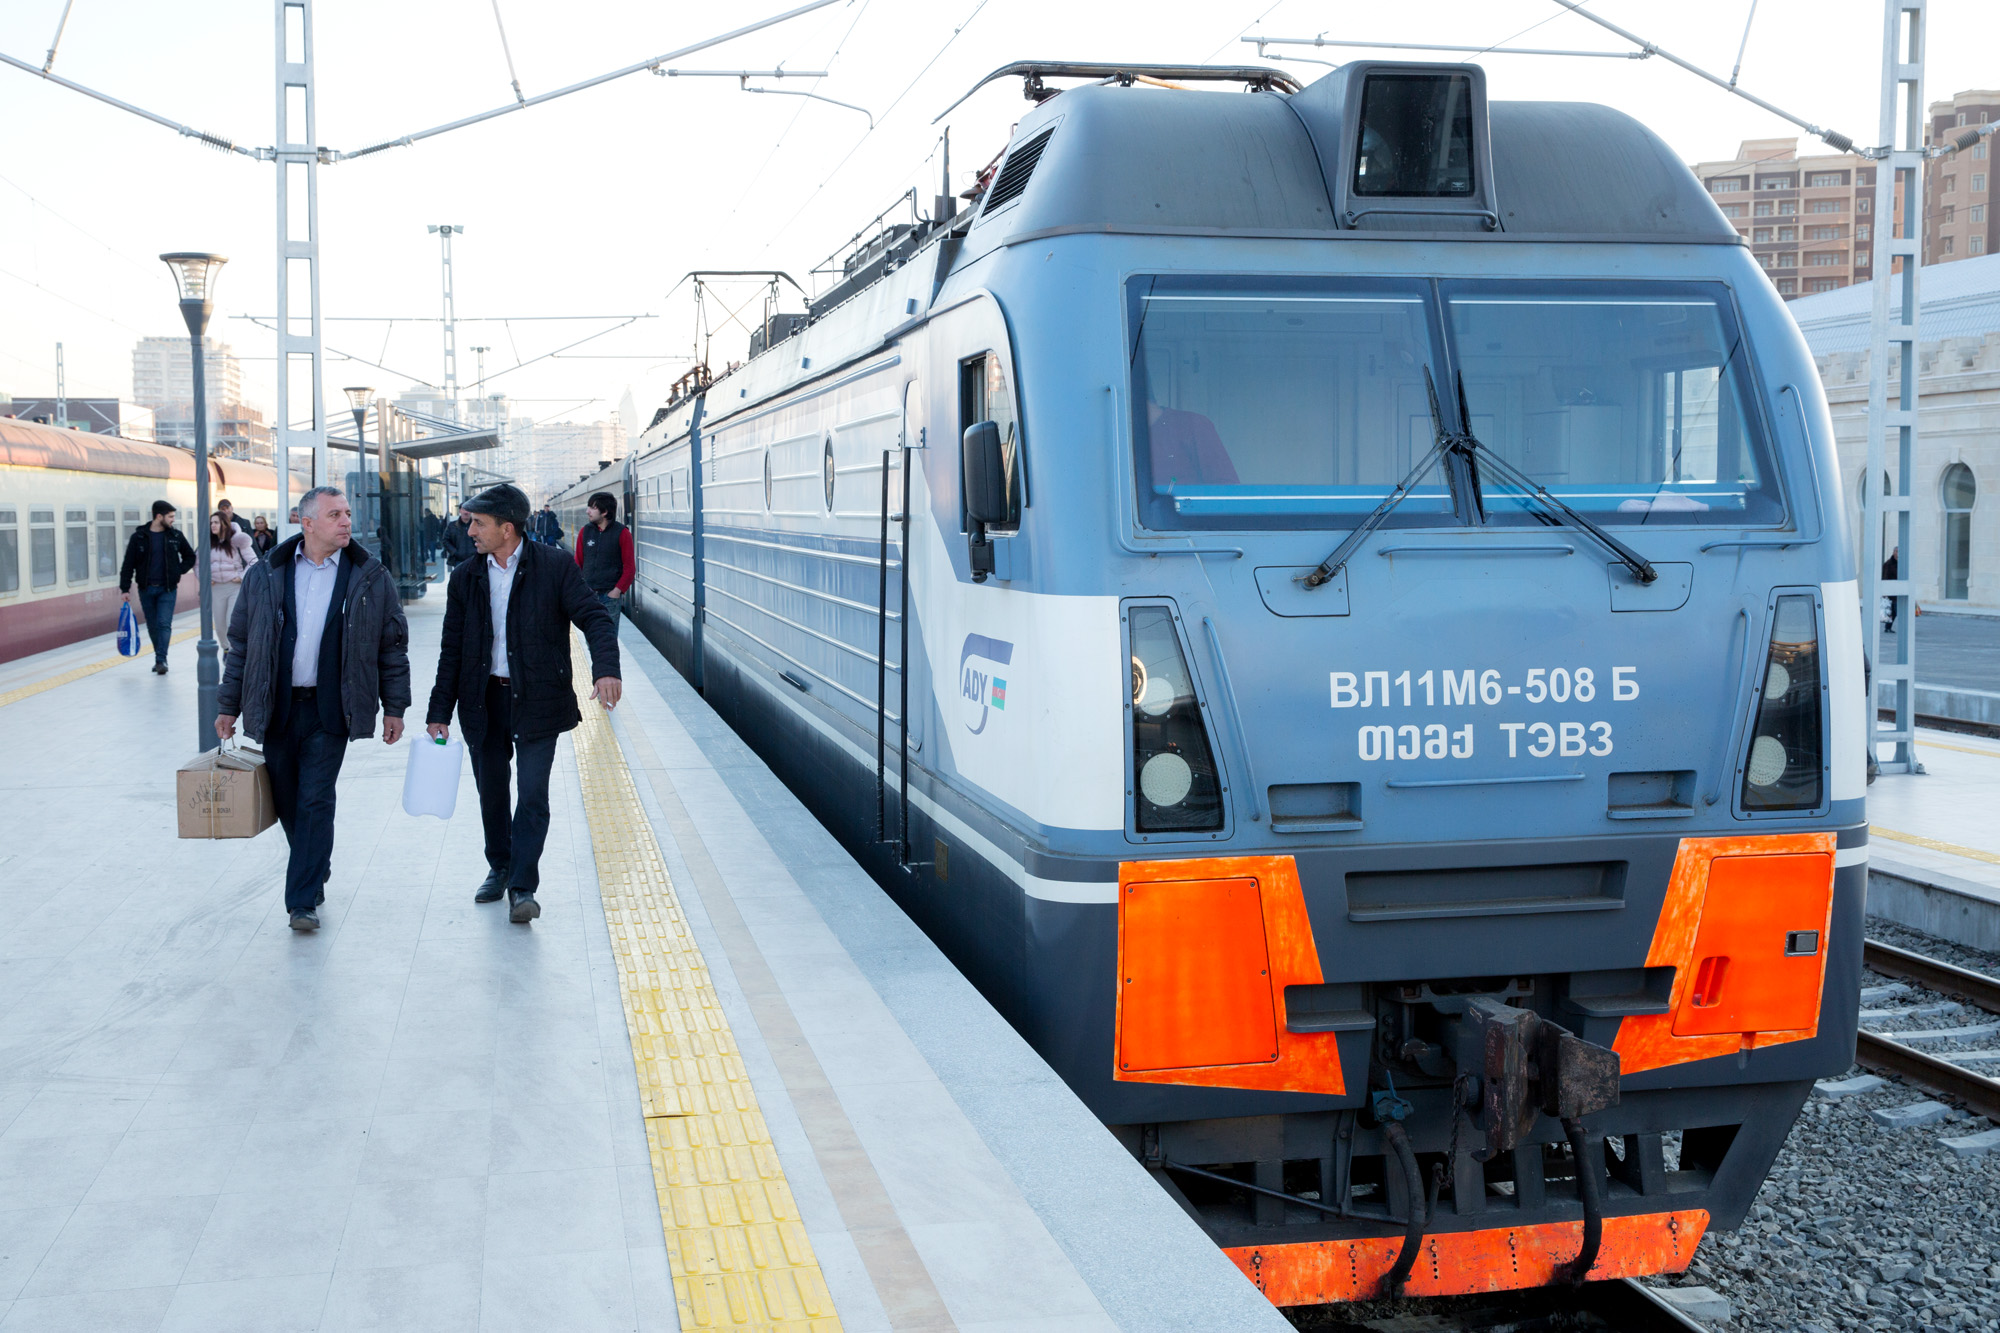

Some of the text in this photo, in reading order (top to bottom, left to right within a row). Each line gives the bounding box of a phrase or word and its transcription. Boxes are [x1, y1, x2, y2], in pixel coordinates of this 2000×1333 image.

[963, 667, 988, 705] ADY
[1329, 666, 1640, 708] ВЛ11М6-508 Б
[1358, 721, 1614, 761] თემქ ТЭВЗ
